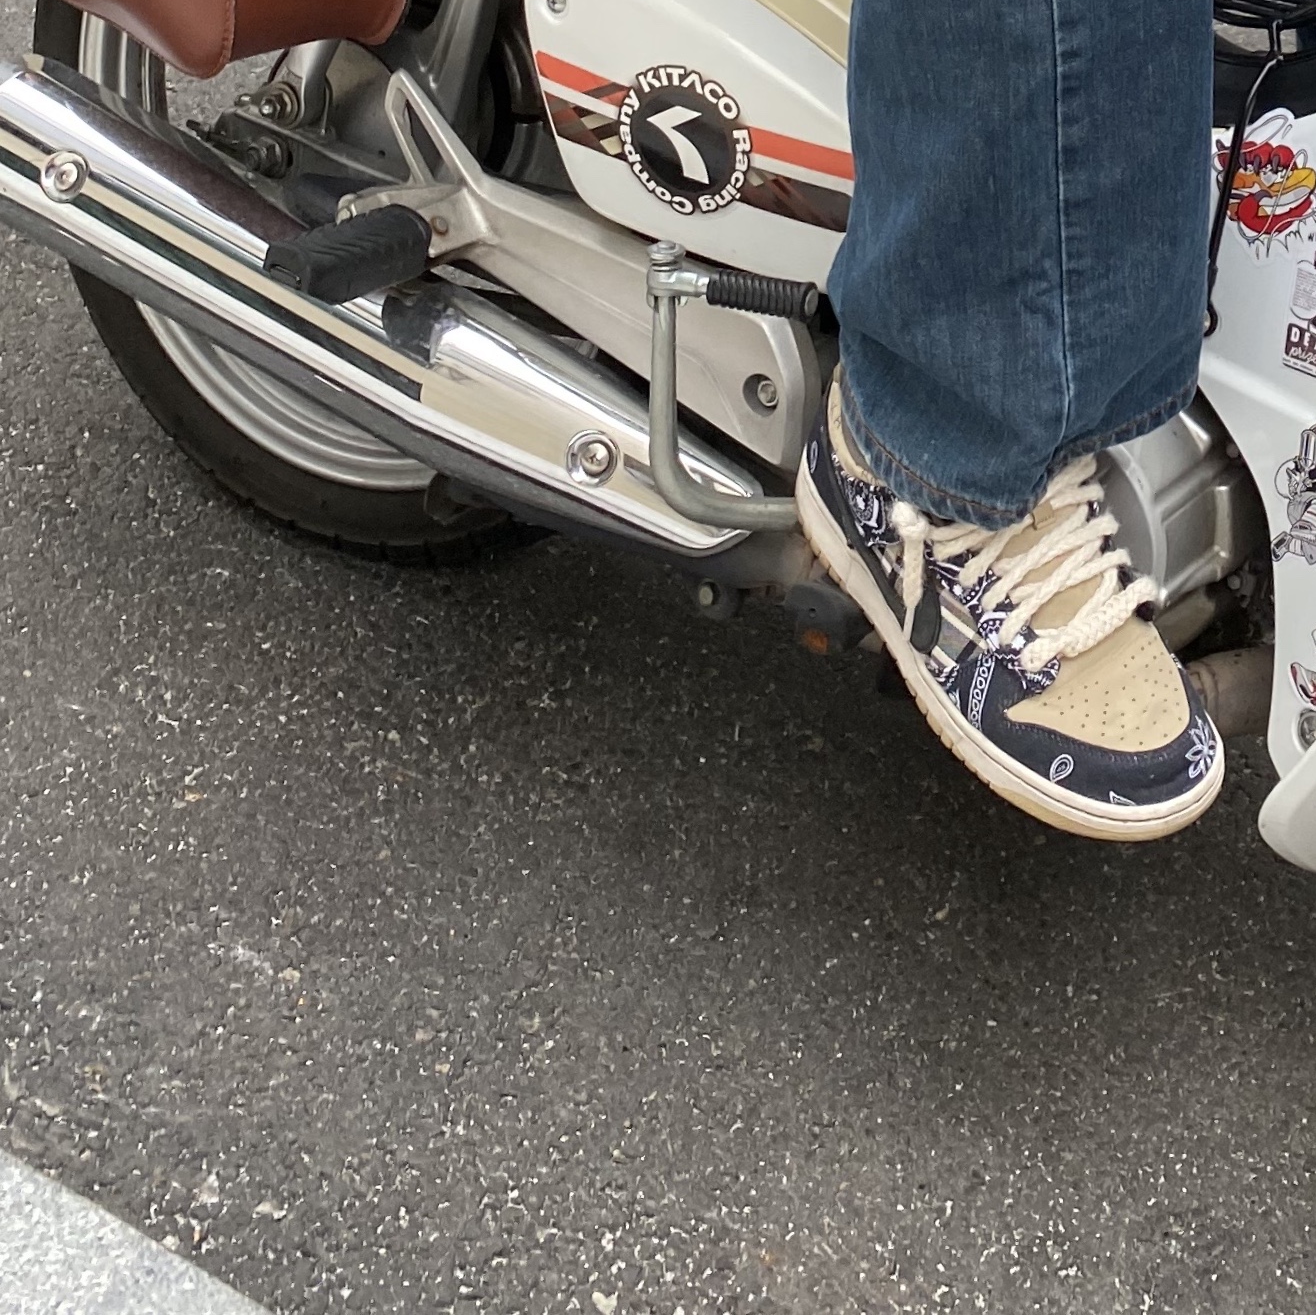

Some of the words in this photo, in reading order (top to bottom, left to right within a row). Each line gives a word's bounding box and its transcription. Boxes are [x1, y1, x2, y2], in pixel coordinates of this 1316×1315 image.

[636, 65, 741, 121] KITACO
[618, 88, 695, 215] Company
[696, 128, 751, 213] Racing
